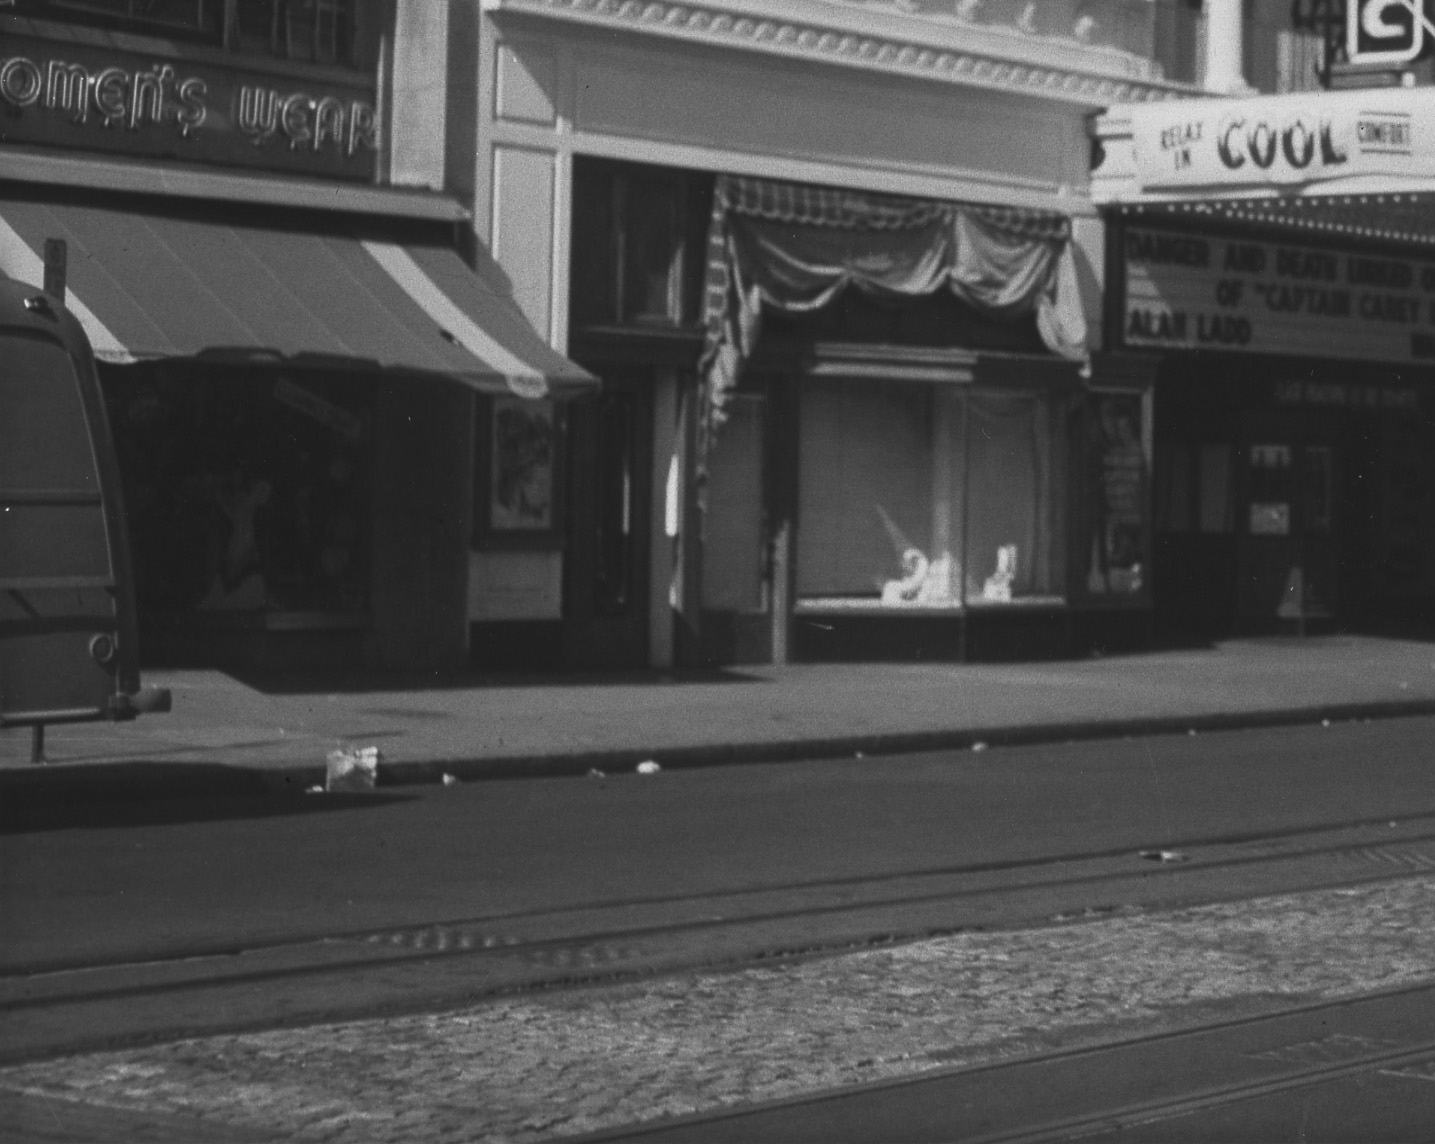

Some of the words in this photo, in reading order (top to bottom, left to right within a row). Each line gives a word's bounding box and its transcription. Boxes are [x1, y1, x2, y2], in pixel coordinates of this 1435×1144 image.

[1160, 120, 1204, 151] RELAX
[1216, 112, 1350, 172] COOL
[1223, 242, 1266, 274] AND
[1216, 279, 1244, 308] OF
[1130, 309, 1187, 339] ALAN
[1198, 314, 1252, 345] LADD
